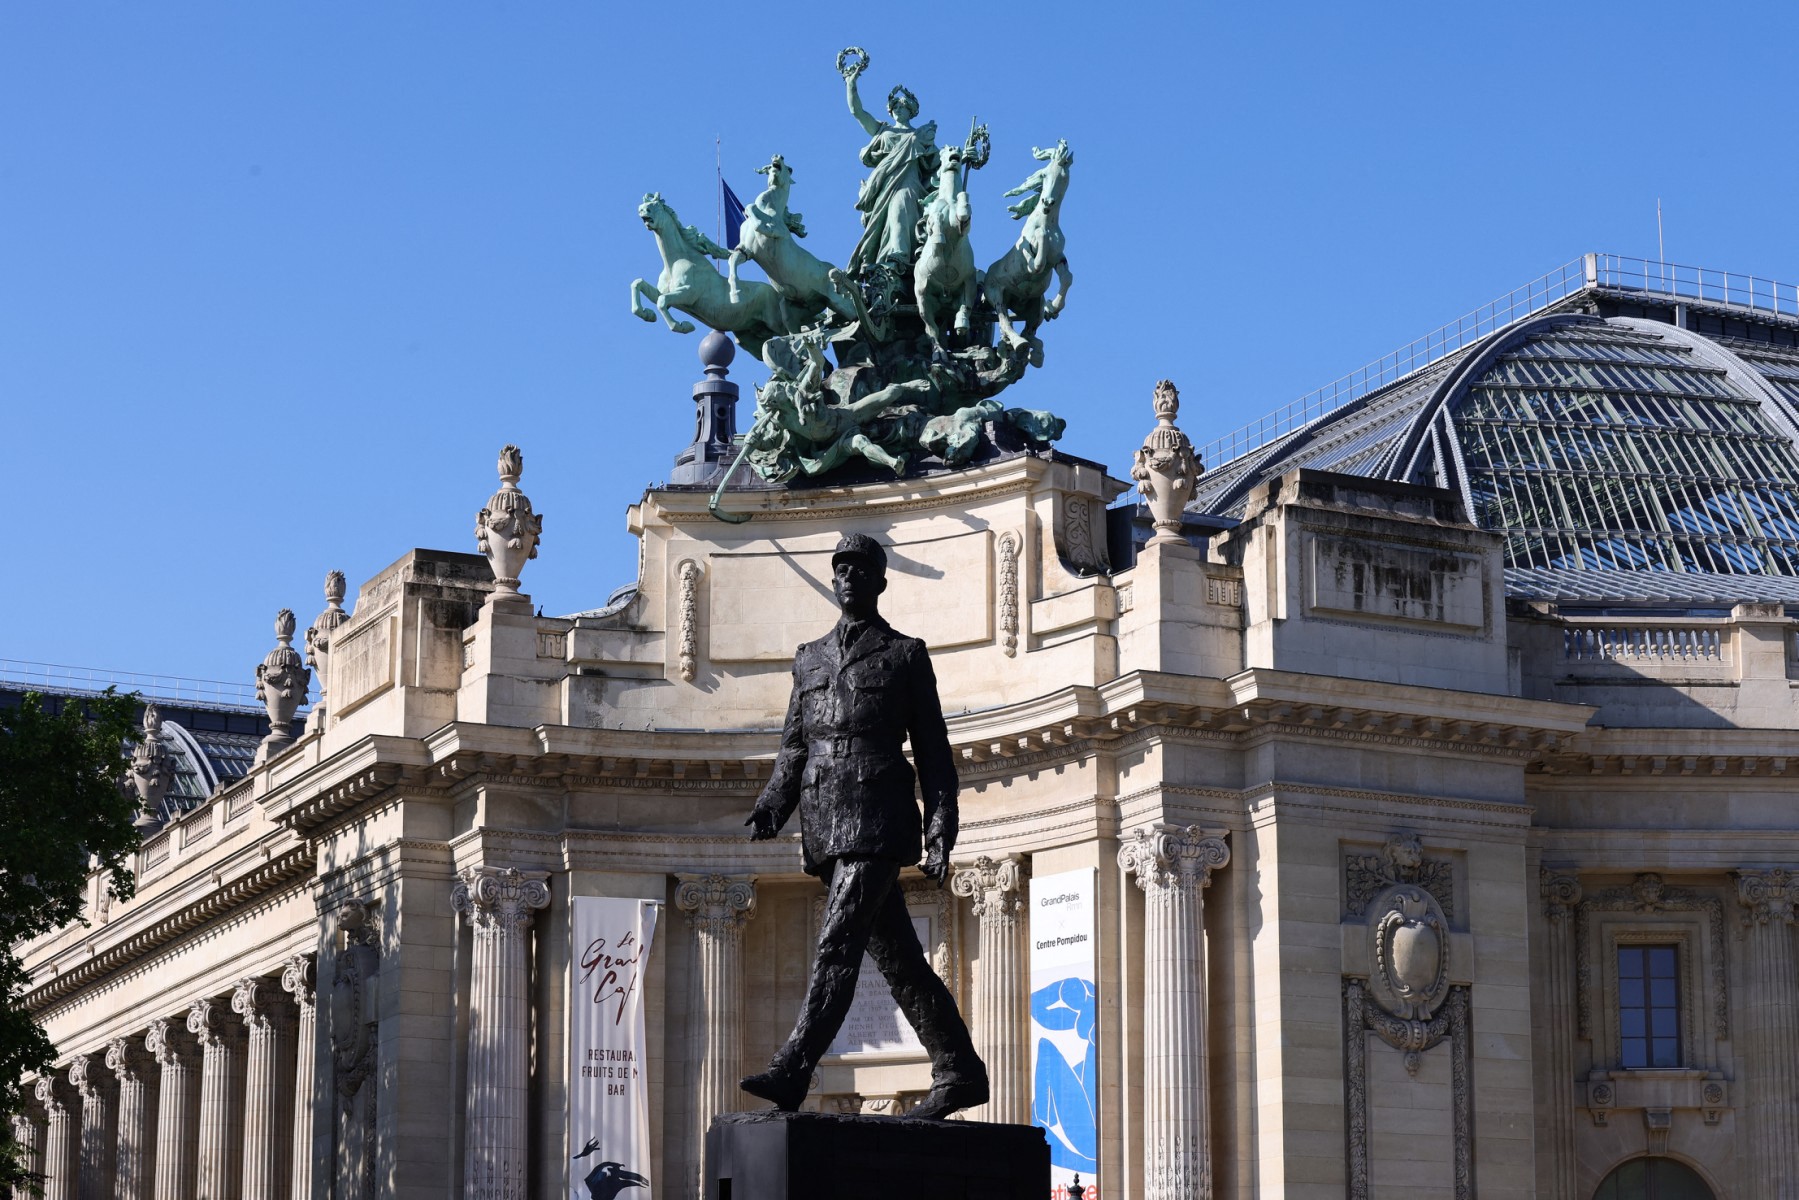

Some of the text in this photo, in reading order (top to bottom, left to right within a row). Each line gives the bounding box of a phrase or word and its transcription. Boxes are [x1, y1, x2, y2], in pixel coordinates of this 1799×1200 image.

[1040, 892, 1080, 907] GrandPalais
[617, 931, 635, 948] Le
[1036, 933, 1088, 950] Centre Pompidou
[593, 970, 637, 1026] Caf
[588, 1049, 636, 1062] RESTAURA
[582, 1065, 614, 1078] FRUITS
[617, 1067, 629, 1079] DE
[607, 1083, 625, 1096] BAR
